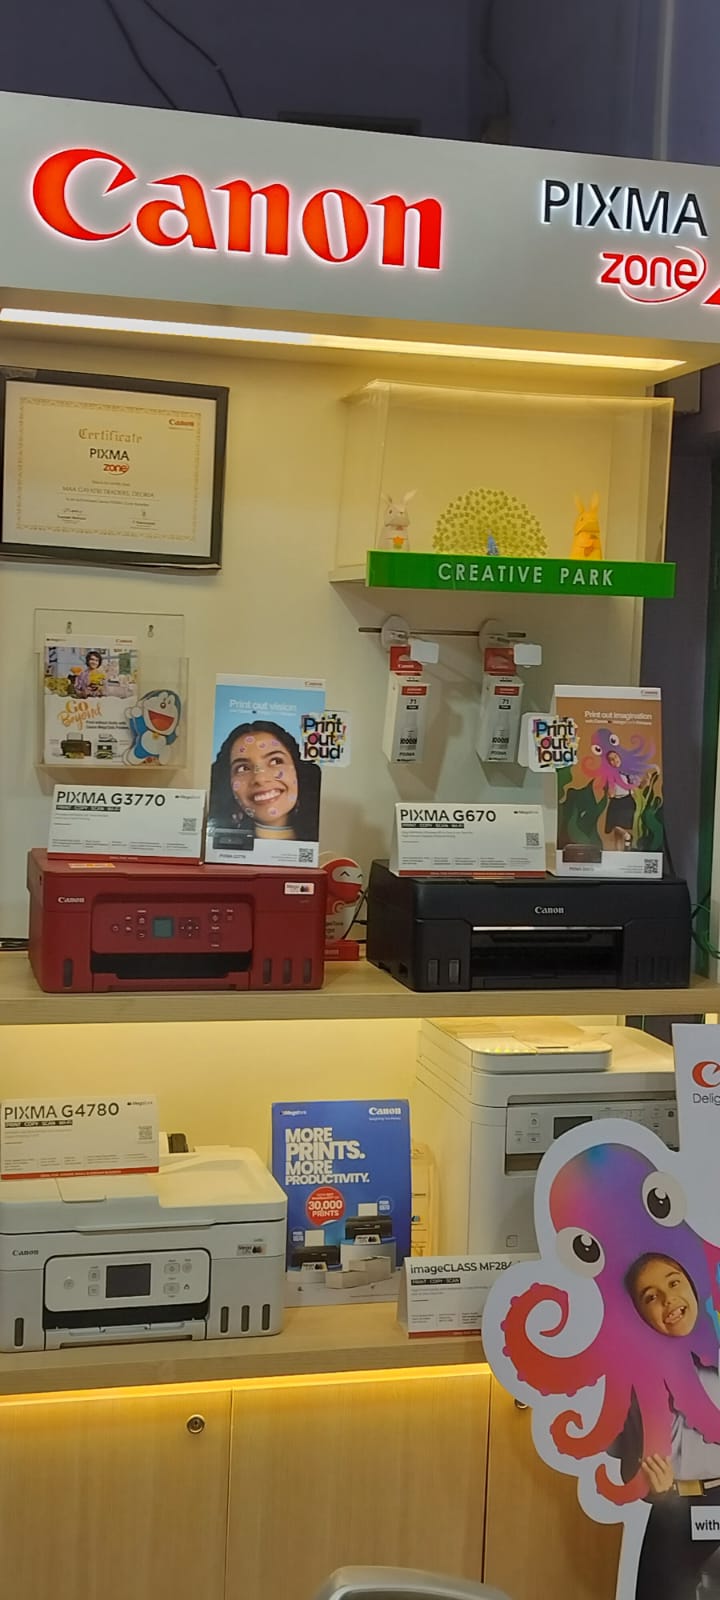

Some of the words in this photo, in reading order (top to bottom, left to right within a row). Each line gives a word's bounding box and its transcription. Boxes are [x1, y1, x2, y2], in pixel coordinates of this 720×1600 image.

[32, 148, 442, 270] Canon
[542, 179, 708, 237] PIXMA
[600, 249, 704, 297] zone
[78, 427, 143, 444] Certificate
[89, 447, 130, 462] PIXMA
[103, 462, 130, 475] zone
[438, 562, 543, 584] CREATIVE
[560, 567, 614, 587] PARK
[308, 732, 336, 746] out
[541, 736, 568, 750] out
[56, 791, 108, 805] PIXMA
[111, 792, 166, 807] G3770
[400, 809, 449, 822] PIXMA
[453, 810, 497, 822] G670
[58, 896, 85, 904] Canon
[534, 905, 564, 915] Canon
[4, 1105, 58, 1120] PIXMA
[61, 1102, 120, 1118] G4780
[368, 1106, 402, 1115] Canon
[285, 1127, 333, 1143] MORE
[285, 1140, 366, 1161] PRINTS.
[285, 1160, 333, 1176] MORE
[284, 1172, 370, 1185] PRODUCTIVITY.
[308, 1200, 343, 1211] 30,000
[11, 1249, 39, 1257] Canon
[410, 1262, 477, 1275] imageCLASS
[694, 1519, 720, 1532] with
